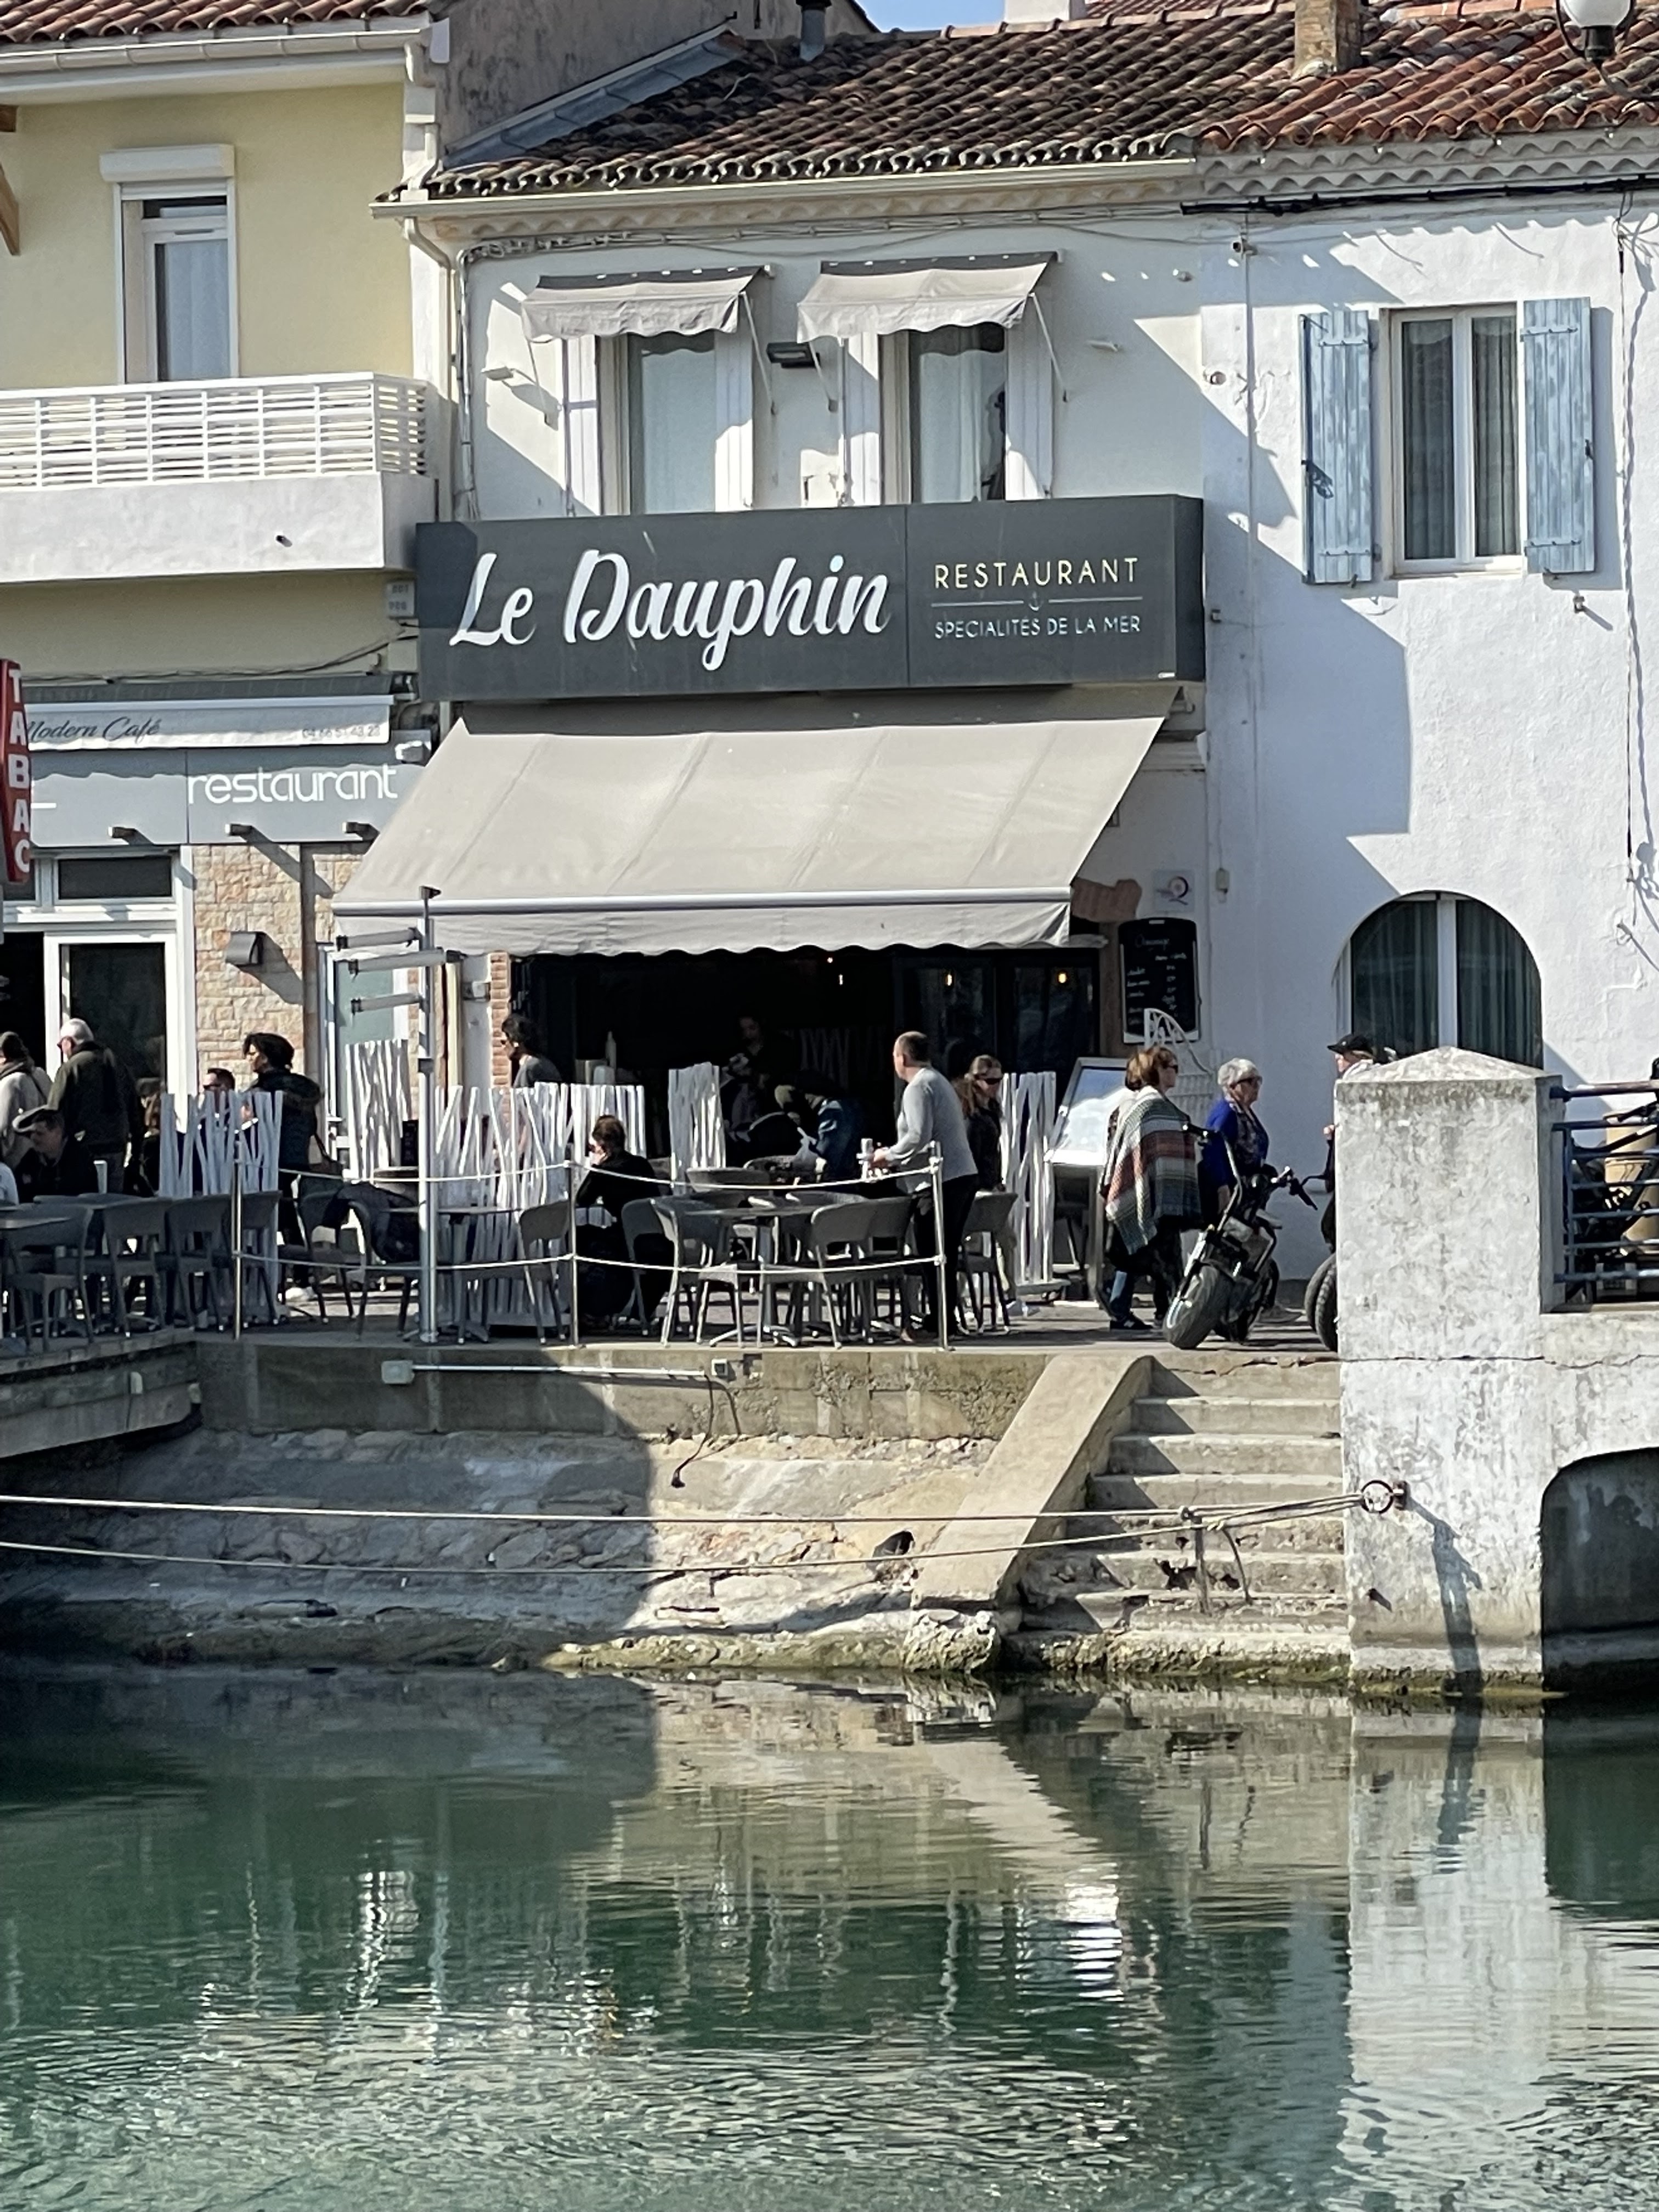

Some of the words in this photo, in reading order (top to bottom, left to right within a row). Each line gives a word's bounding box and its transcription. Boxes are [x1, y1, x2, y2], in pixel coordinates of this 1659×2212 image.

[935, 557, 1138, 589] RESTAURANT
[449, 552, 536, 646] Le
[563, 549, 890, 670] Dauphin
[1047, 617, 1068, 635] DE
[1075, 617, 1097, 634] LA
[1103, 615, 1141, 633] MER
[103, 715, 162, 744] Café
[8, 669, 30, 874] TABAC
[188, 763, 398, 804] restaurant
